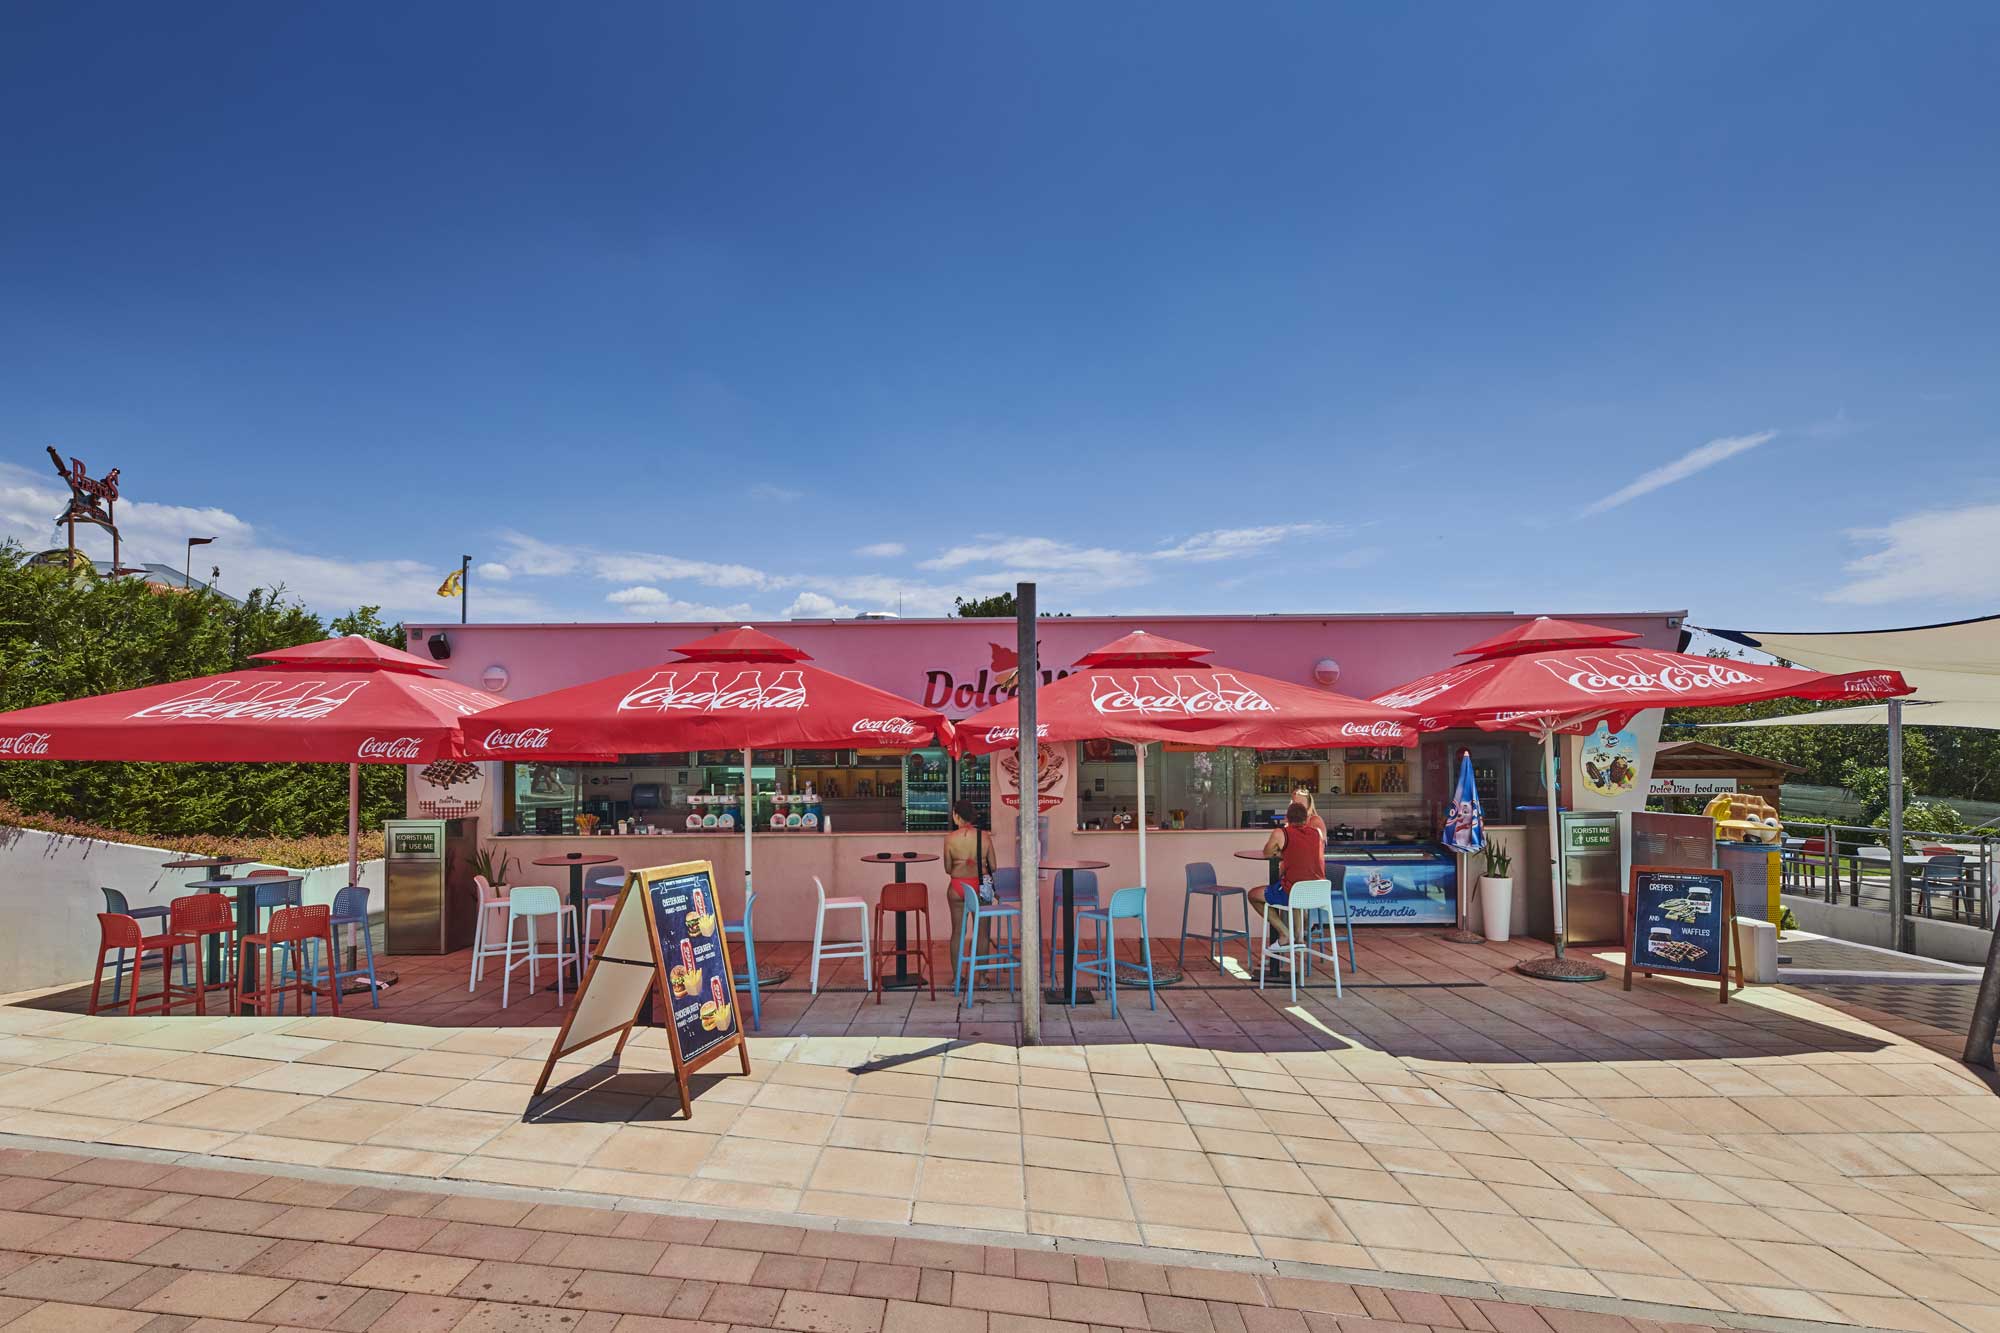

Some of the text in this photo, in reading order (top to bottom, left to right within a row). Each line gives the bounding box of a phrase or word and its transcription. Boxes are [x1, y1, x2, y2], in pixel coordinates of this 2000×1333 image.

[1568, 664, 1753, 693] Coca-Cola
[620, 686, 806, 709] Coca-Cola
[1093, 690, 1272, 713] Coca-Cola
[852, 717, 916, 736] Coca-Cola
[1341, 720, 1403, 737] Coca-Cola
[357, 736, 424, 759] Coca-Cola
[483, 727, 553, 750] Coca-Cola
[1649, 784, 1672, 793] Dolce
[1673, 784, 1690, 793] Vita
[1694, 783, 1713, 794] food
[1649, 884, 1674, 892] CREPES
[1348, 905, 1417, 918] Istralandia
[1681, 928, 1711, 936] WAFFLES
